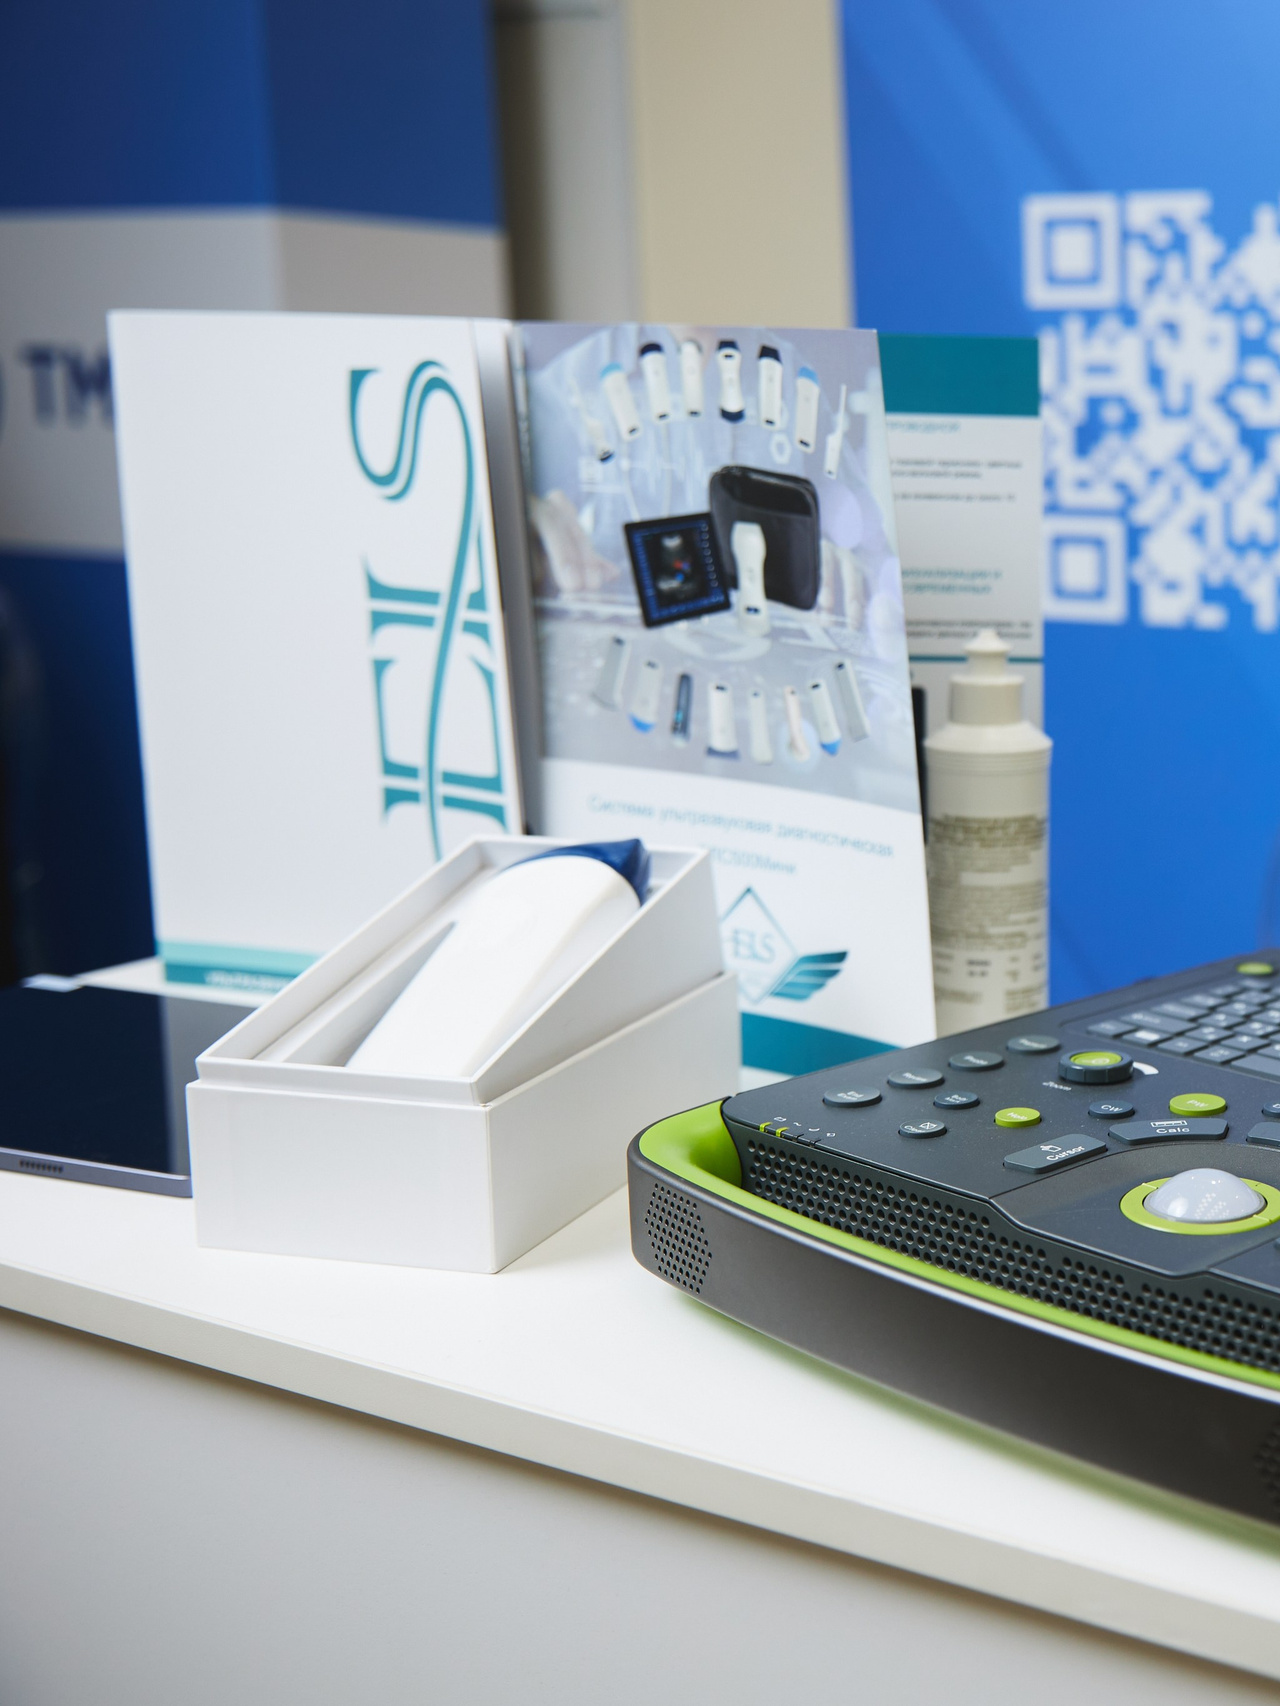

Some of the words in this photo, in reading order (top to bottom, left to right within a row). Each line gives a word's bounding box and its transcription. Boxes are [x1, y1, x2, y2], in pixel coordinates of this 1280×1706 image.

[588, 796, 655, 819] Система
[776, 822, 895, 858] диагностическая
[1100, 1104, 1124, 1113] CW
[1155, 1126, 1191, 1135] Calc
[1046, 1145, 1086, 1161] Cursor
